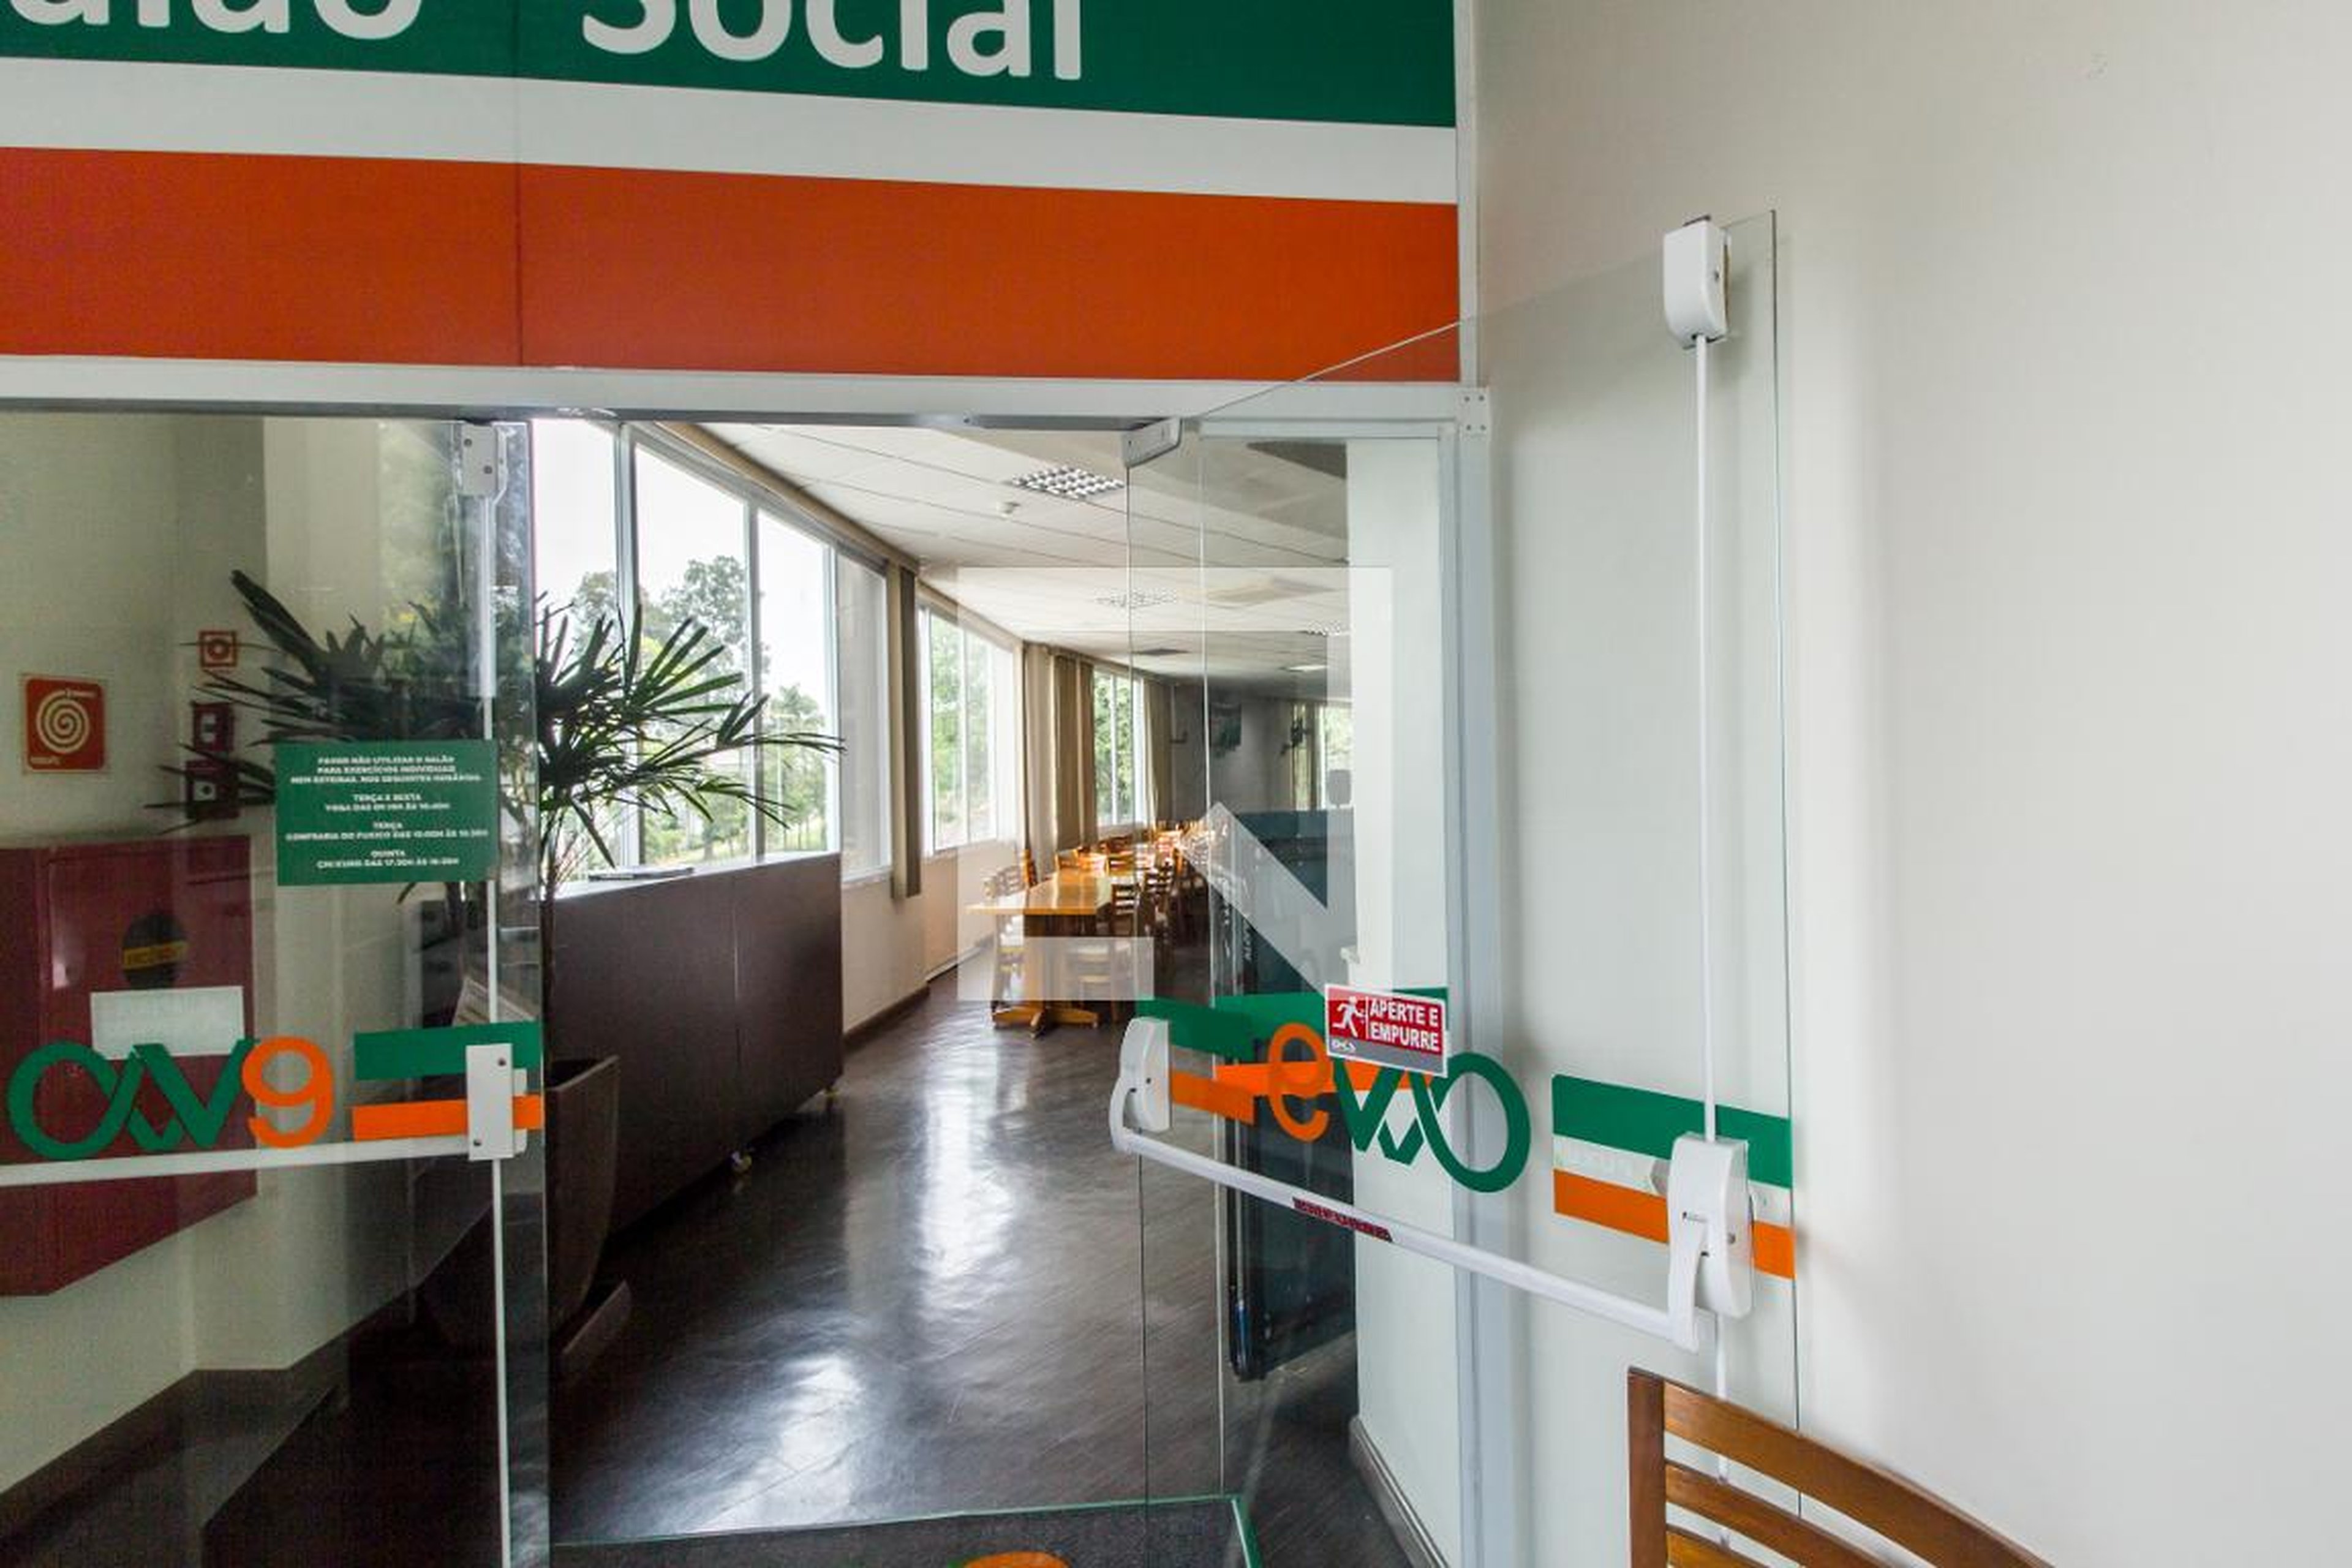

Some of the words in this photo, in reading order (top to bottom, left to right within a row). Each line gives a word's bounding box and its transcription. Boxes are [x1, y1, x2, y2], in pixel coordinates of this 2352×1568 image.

[1370, 998, 1425, 1024] APERTE
[1429, 1008, 1439, 1027] E
[1370, 1021, 1440, 1052] EMPURRE
